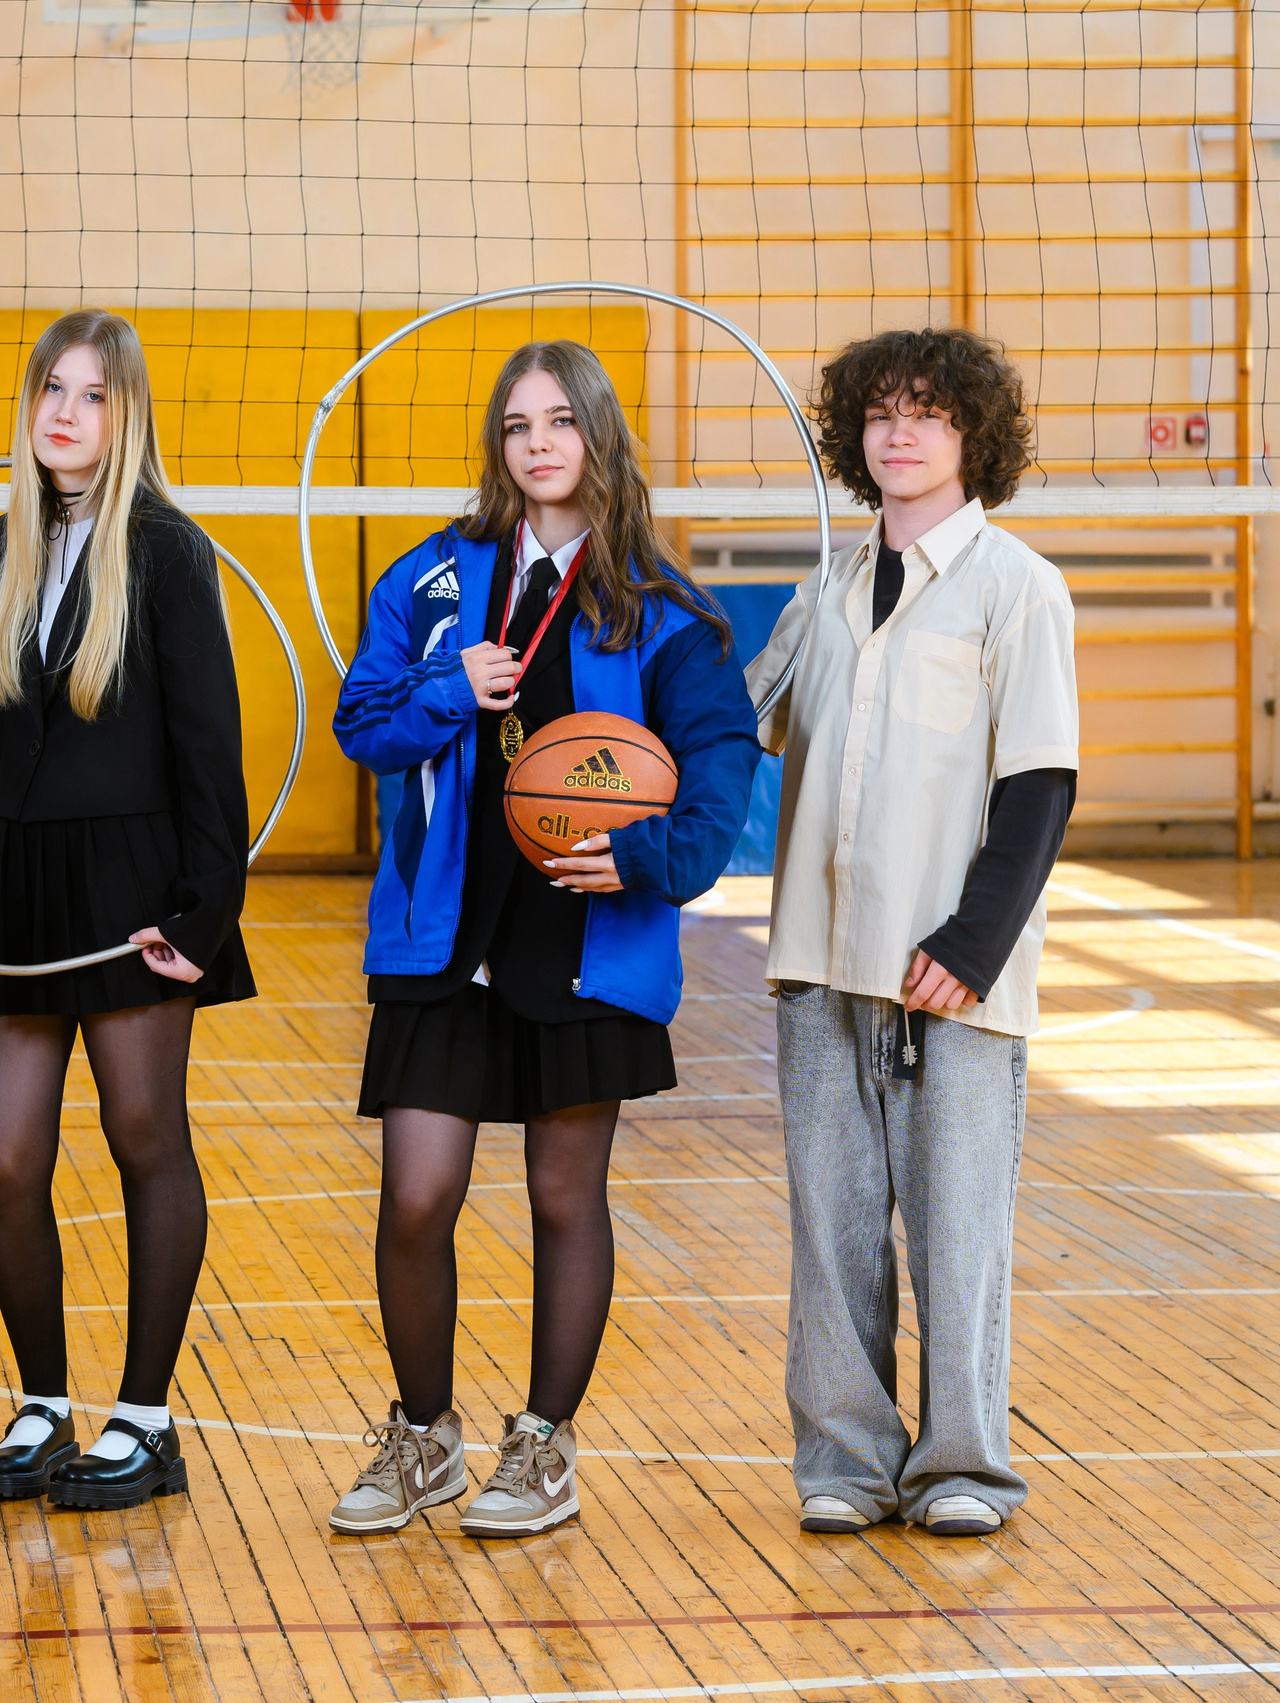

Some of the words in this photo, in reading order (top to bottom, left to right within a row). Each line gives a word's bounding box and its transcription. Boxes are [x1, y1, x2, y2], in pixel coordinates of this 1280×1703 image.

[427, 586, 460, 601] adida
[563, 770, 632, 793] adidas
[537, 812, 619, 840] all-c
